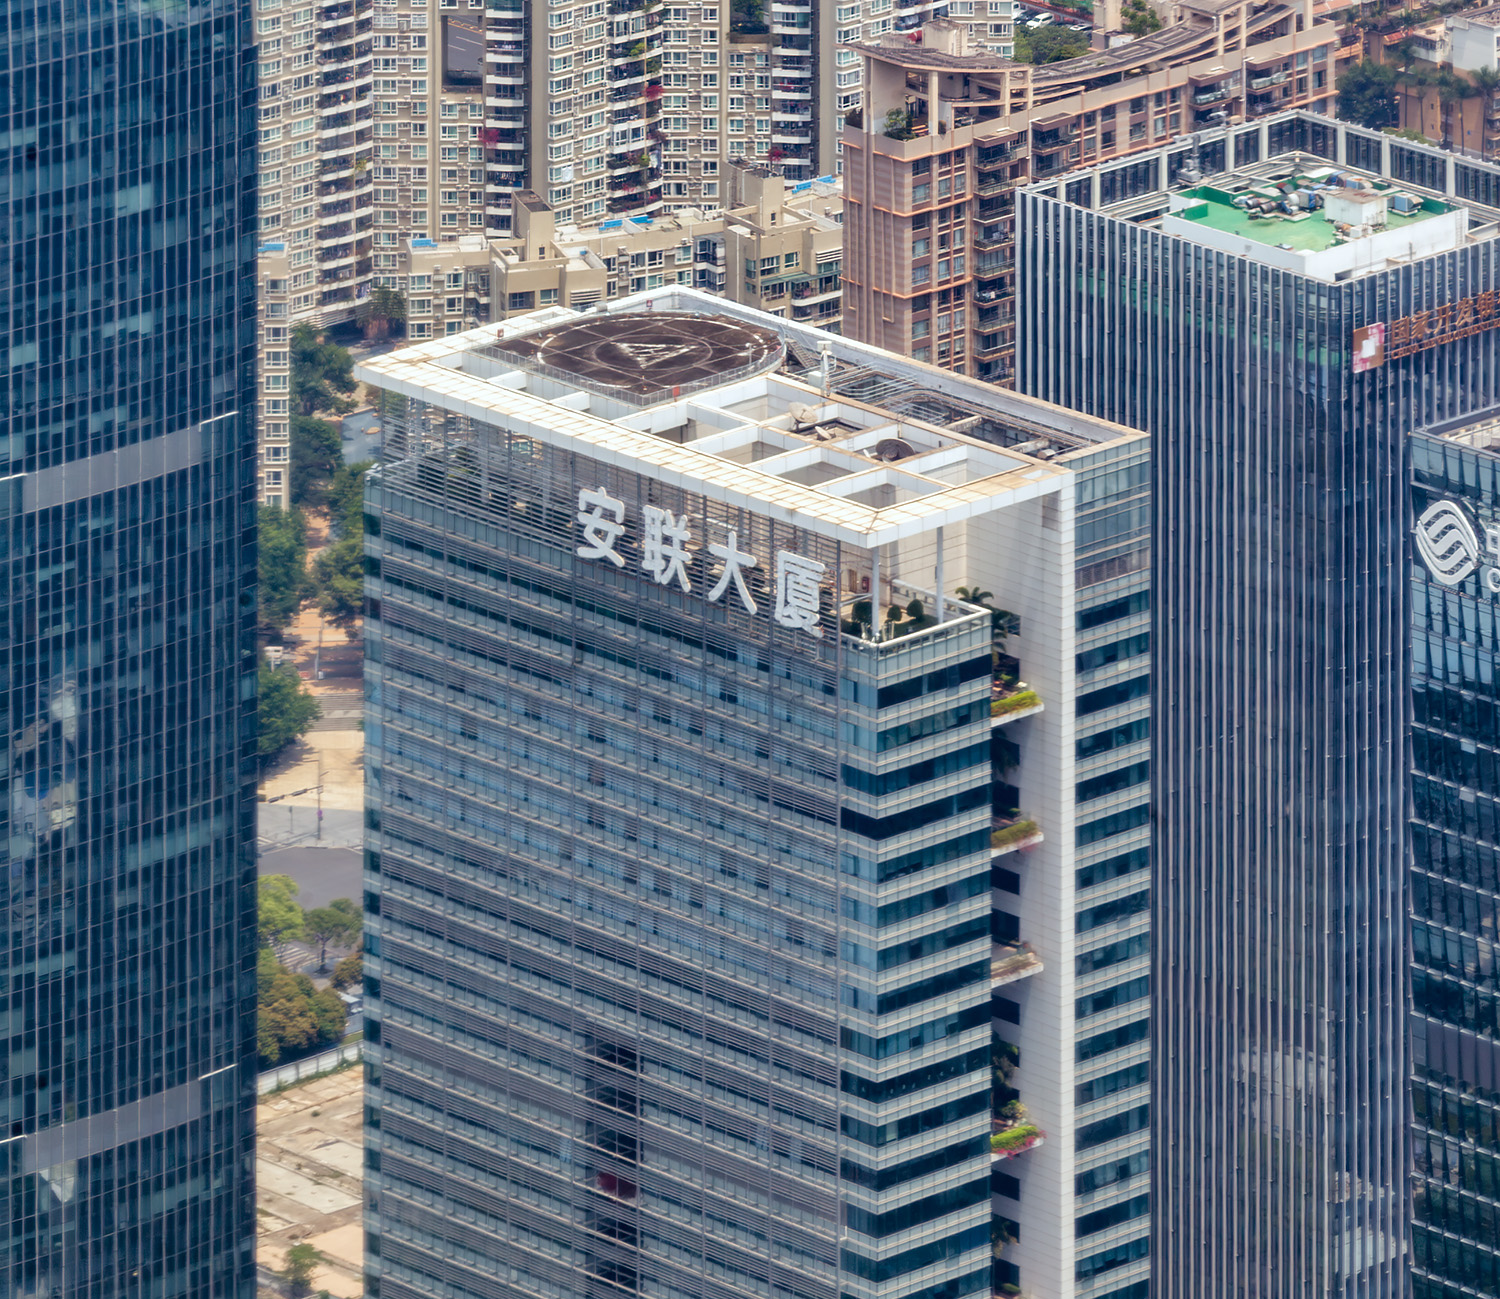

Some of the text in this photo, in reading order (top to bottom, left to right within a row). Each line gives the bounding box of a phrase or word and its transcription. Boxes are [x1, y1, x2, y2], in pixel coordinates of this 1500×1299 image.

[1391, 290, 1500, 348] 国家开发银
[577, 486, 826, 638] 安联大厦
